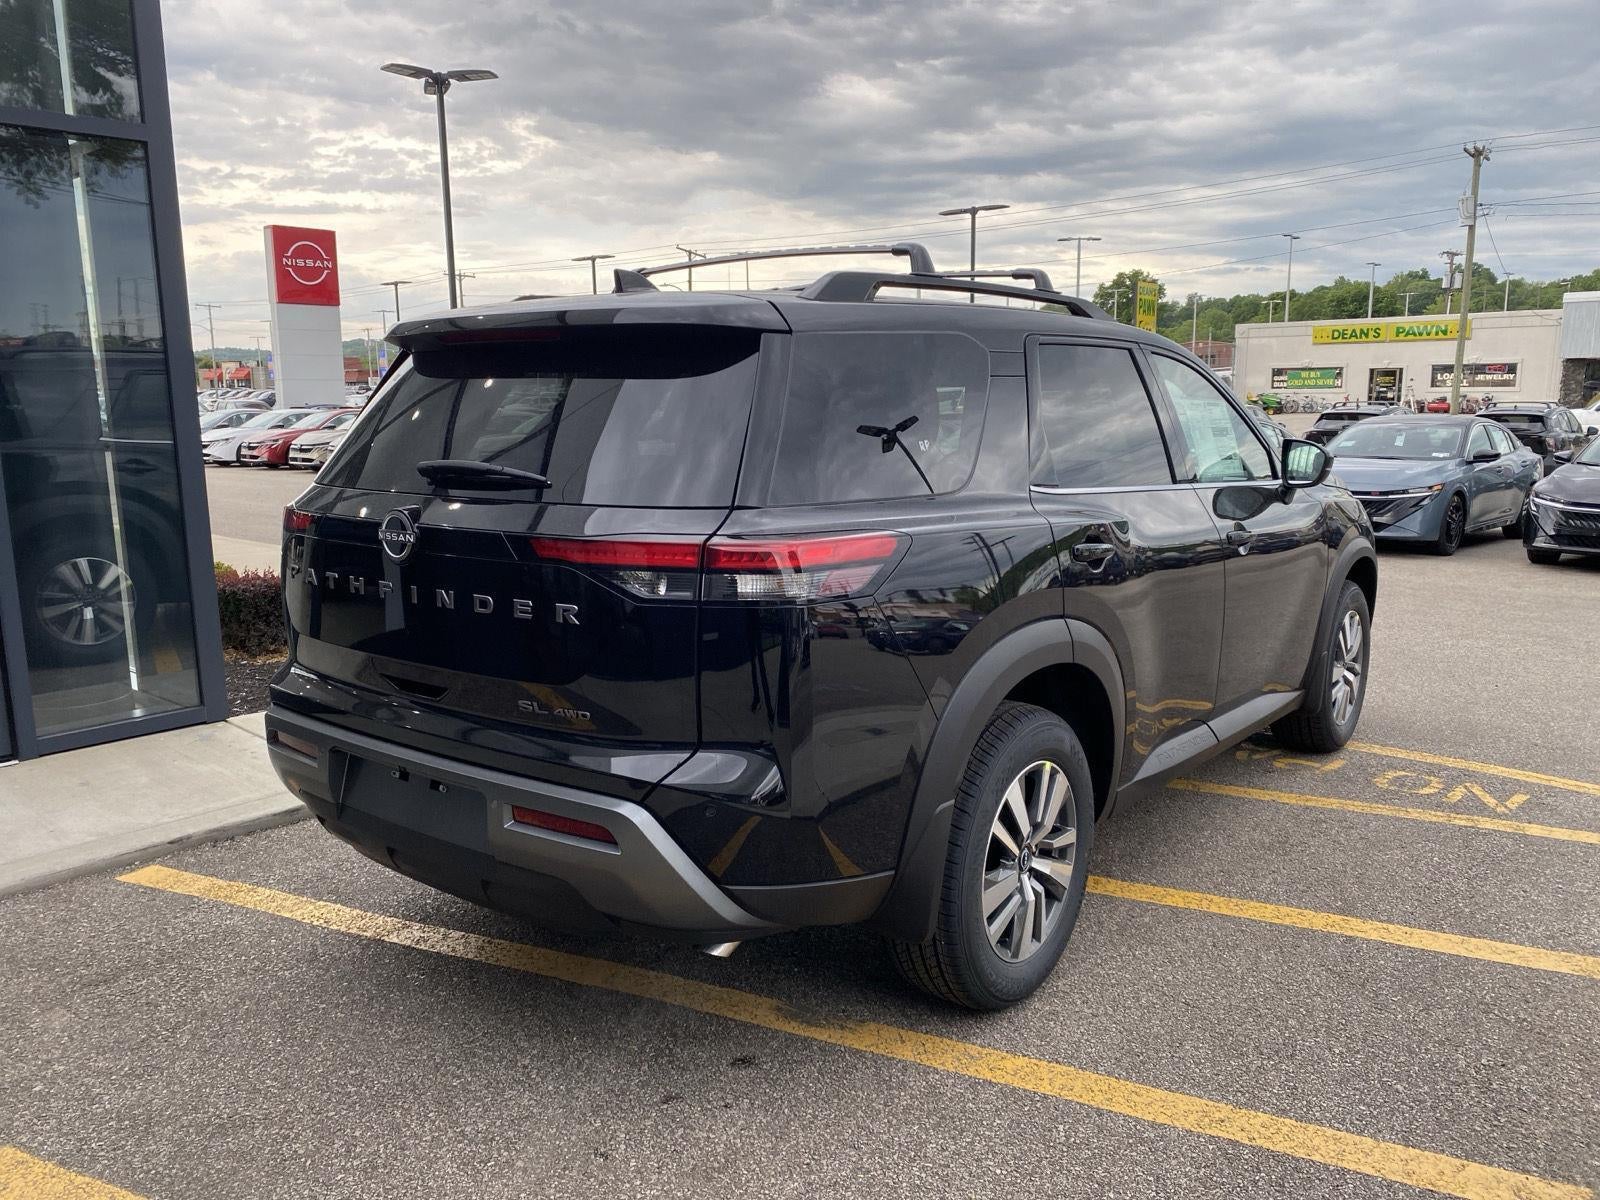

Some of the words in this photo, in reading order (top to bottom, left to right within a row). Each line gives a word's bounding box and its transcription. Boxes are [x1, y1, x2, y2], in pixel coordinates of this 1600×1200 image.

[282, 256, 333, 269] NISSAN
[1331, 327, 1381, 340] DEAN'S
[1395, 324, 1448, 338] PAWN
[1317, 378, 1334, 386] SILVER
[378, 529, 415, 543] NISSAN
[288, 563, 580, 625] PATHFINDER
[517, 699, 549, 714] SL
[553, 708, 591, 721] 4WD
[1371, 769, 1530, 814] NO
